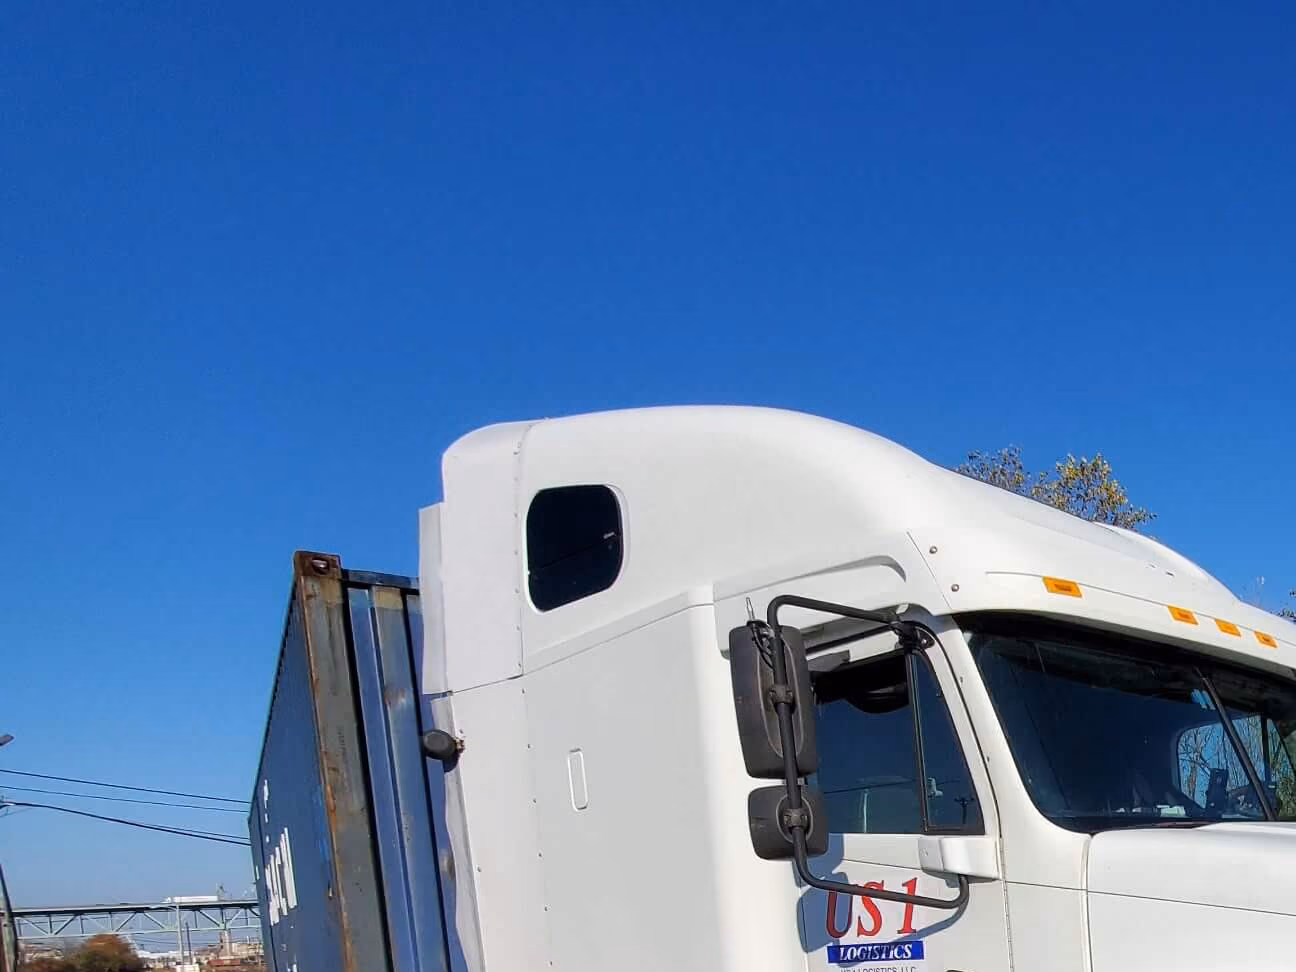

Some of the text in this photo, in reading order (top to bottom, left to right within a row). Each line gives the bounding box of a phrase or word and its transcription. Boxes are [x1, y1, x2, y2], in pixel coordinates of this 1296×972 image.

[826, 877, 918, 939] US 1
[839, 944, 913, 961] LOGISTICS
